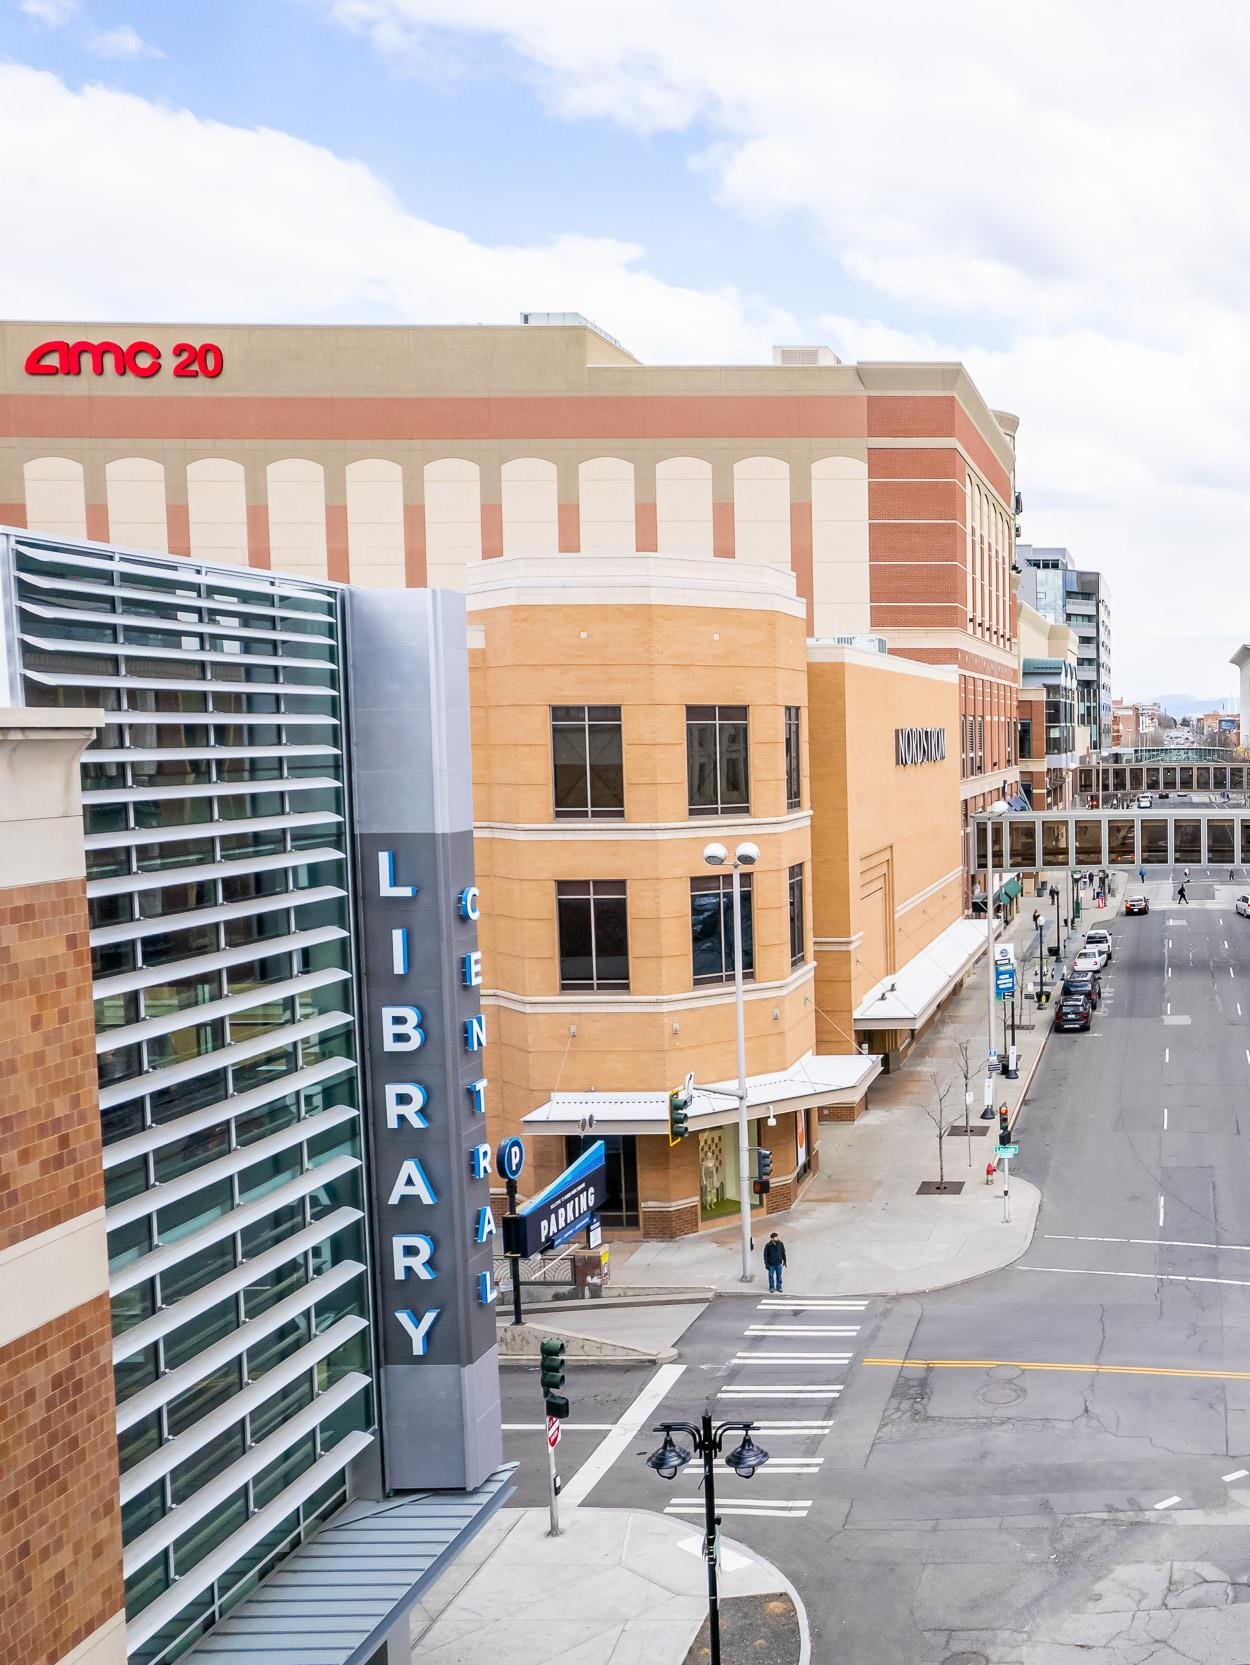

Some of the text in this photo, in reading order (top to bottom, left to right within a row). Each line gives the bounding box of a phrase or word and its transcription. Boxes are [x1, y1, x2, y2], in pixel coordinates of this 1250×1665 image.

[173, 343, 223, 378] 20
[896, 728, 945, 765] NORDSTROM
[378, 849, 441, 1356] LIBRARY
[462, 886, 497, 1304] CENTRAL
[511, 1146, 520, 1171] P
[540, 1186, 595, 1242] PARKING
